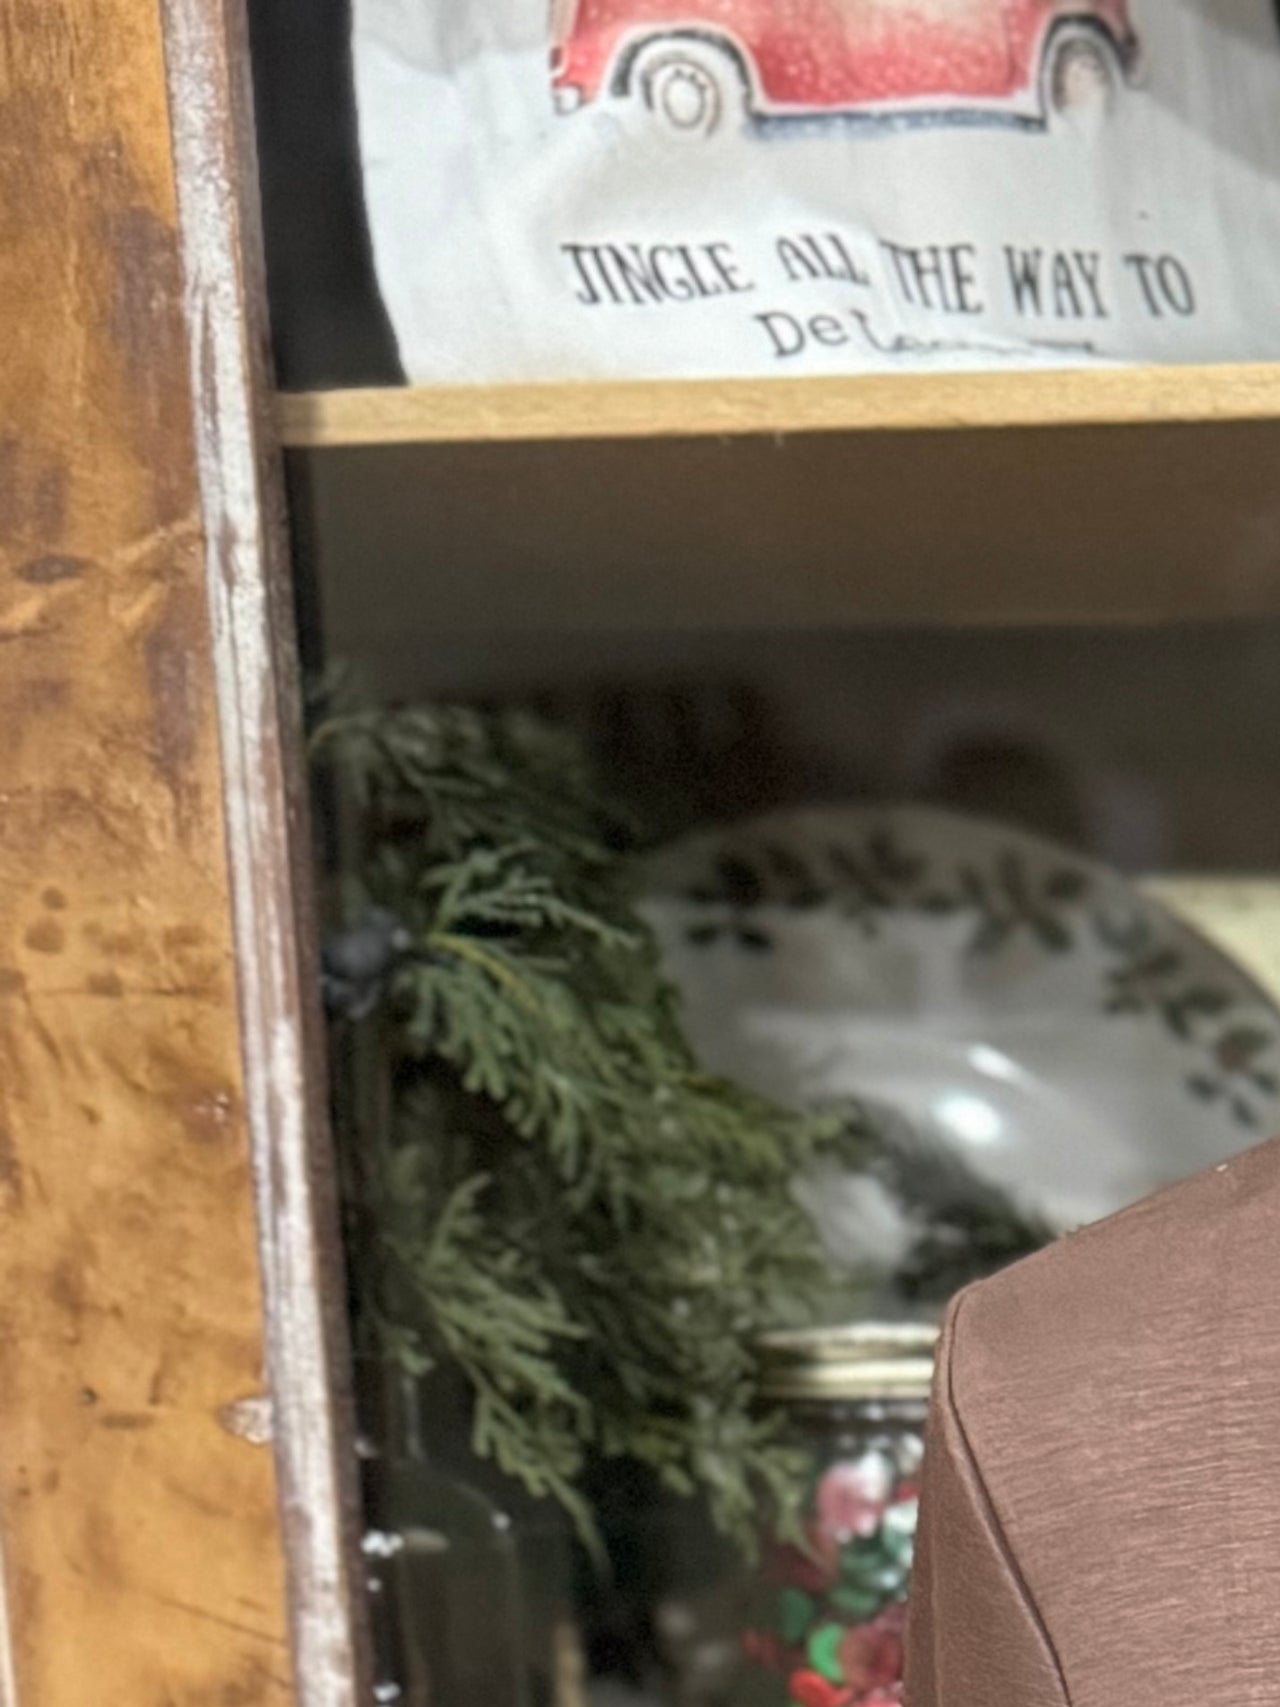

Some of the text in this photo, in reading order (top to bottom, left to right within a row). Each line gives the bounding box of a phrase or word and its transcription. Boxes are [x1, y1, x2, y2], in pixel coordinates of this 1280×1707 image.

[560, 233, 1197, 318] JINGLE ALL THE WAY TO
